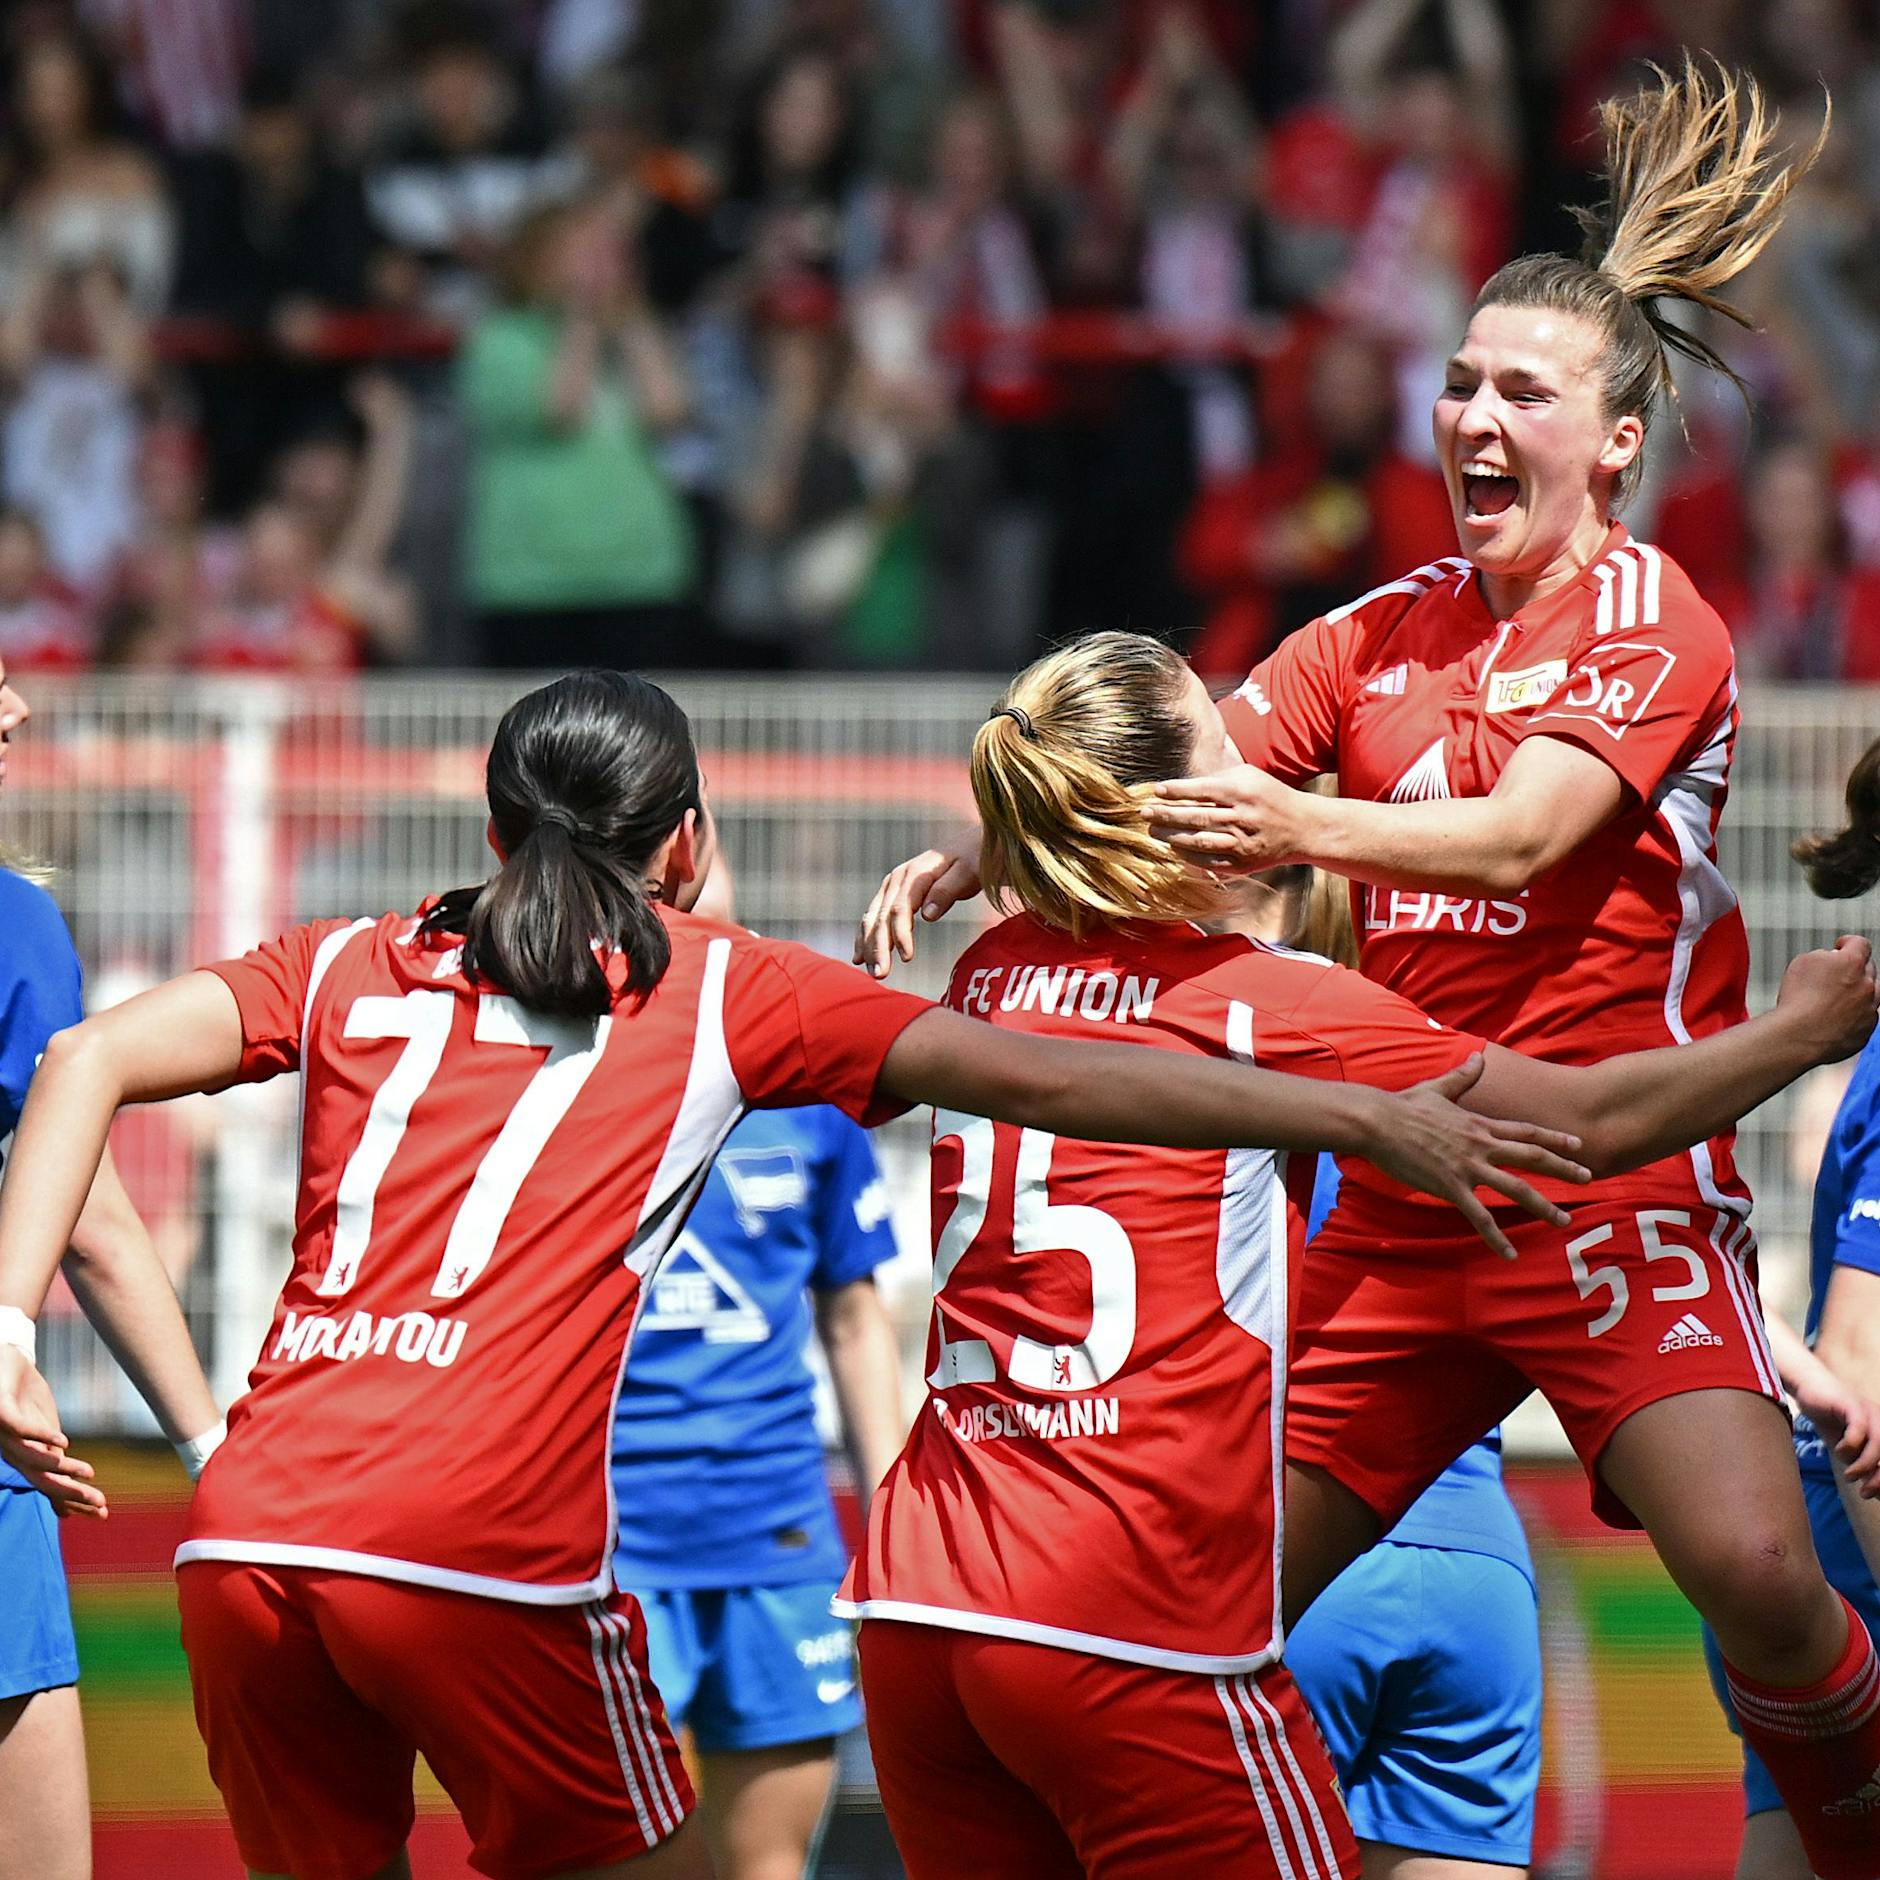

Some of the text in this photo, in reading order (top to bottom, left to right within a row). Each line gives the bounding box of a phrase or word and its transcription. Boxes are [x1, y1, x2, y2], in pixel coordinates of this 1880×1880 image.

[1000, 965, 1160, 1024] UNION
[315, 989, 613, 1299] 77
[926, 1105, 1137, 1392] 25
[1565, 1209, 1711, 1339] 55
[1657, 1333, 1724, 1354] adidas
